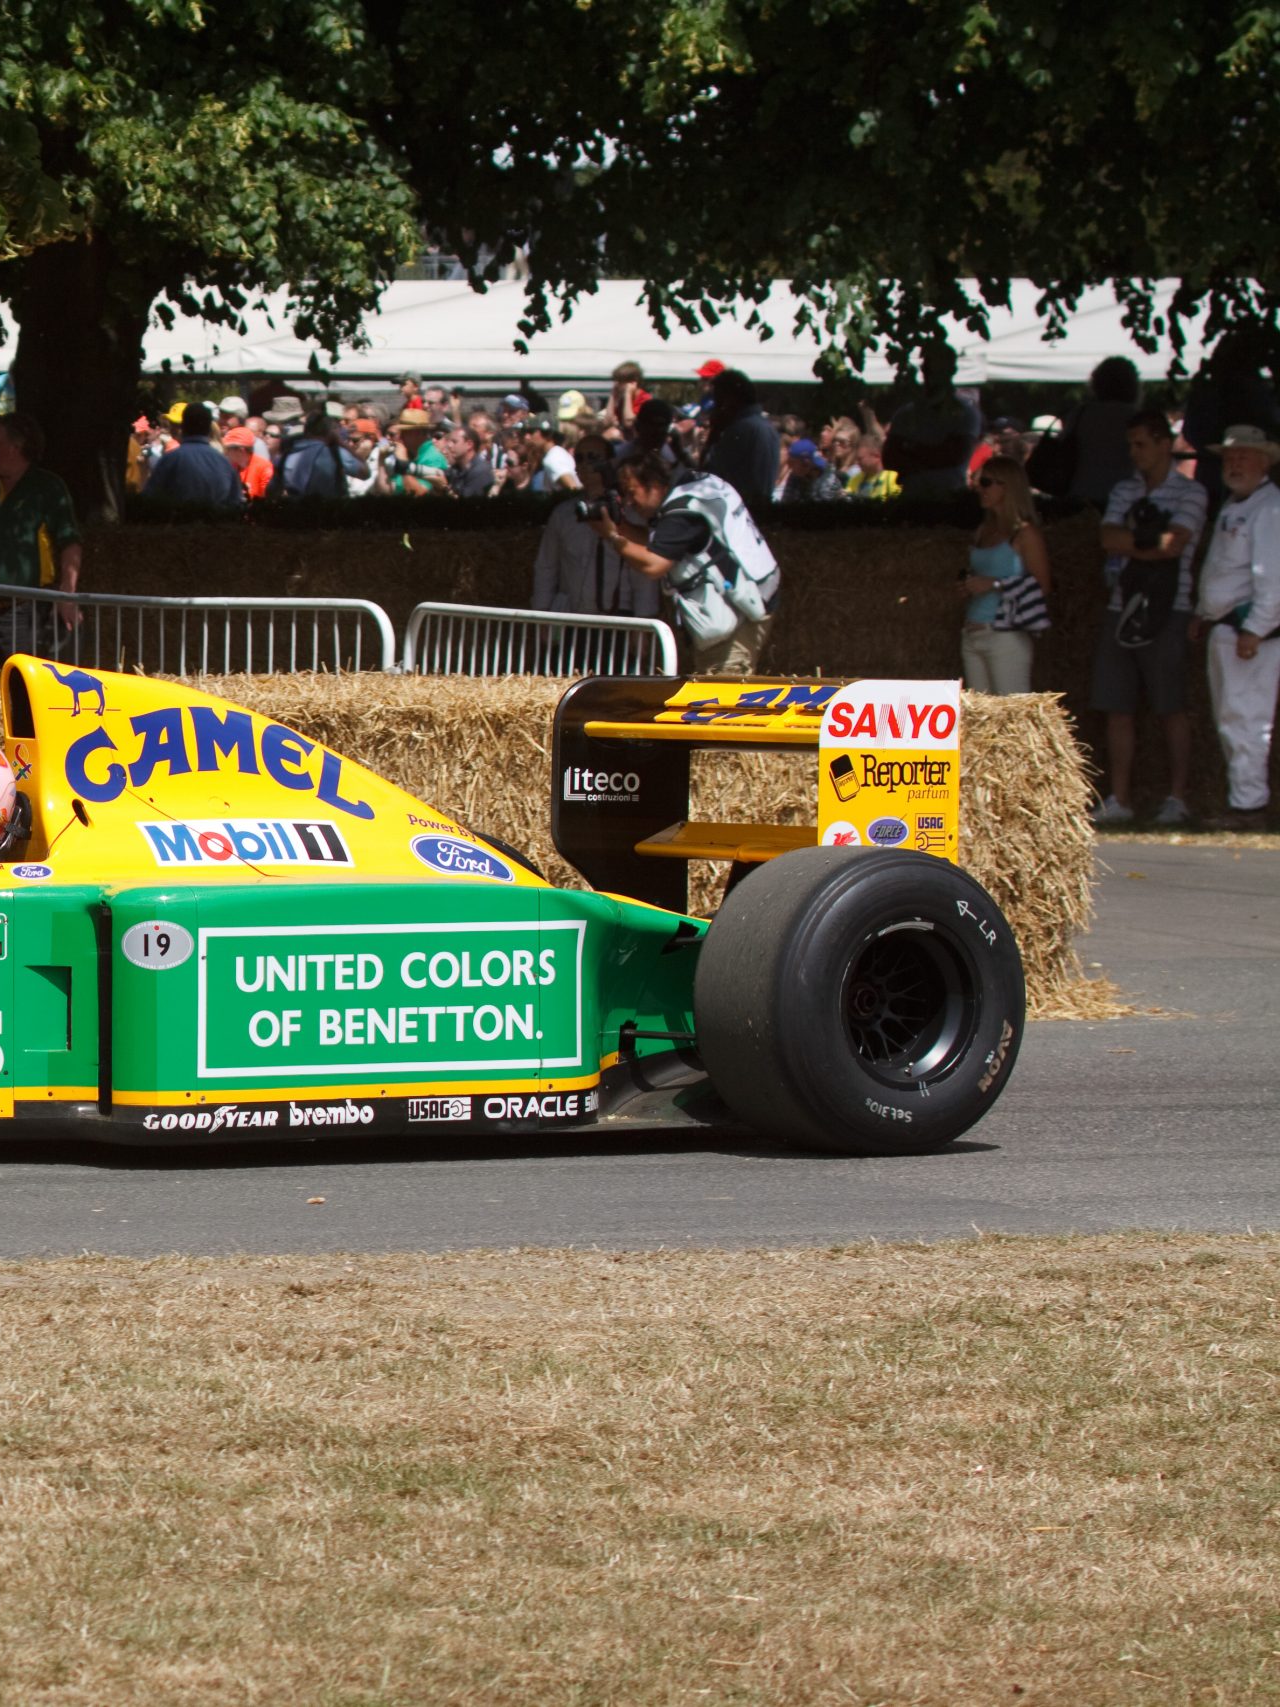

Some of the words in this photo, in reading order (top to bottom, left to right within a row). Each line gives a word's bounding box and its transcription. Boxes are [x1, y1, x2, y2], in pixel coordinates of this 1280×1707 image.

[828, 700, 956, 740] SANYO
[65, 706, 375, 820] CAMEL
[860, 754, 950, 793] Reporter
[907, 785, 950, 802] parfum
[407, 813, 455, 833] Power
[917, 817, 943, 829] USAG
[144, 822, 298, 861] Mobil
[306, 824, 333, 860] 1
[20, 865, 48, 878] Ford
[437, 841, 494, 875] Ford
[144, 933, 170, 957] 19
[978, 919, 997, 945] LR
[235, 953, 383, 992] UNITED
[400, 949, 556, 989] COLORS
[249, 1010, 302, 1047] OF
[319, 1004, 543, 1045] BENETTON.
[977, 1018, 1014, 1094] AVON
[143, 1105, 279, 1133] GOODYEAR
[289, 1099, 374, 1126] brembo
[409, 1099, 450, 1119] USAG
[484, 1095, 578, 1118] ORACLE
